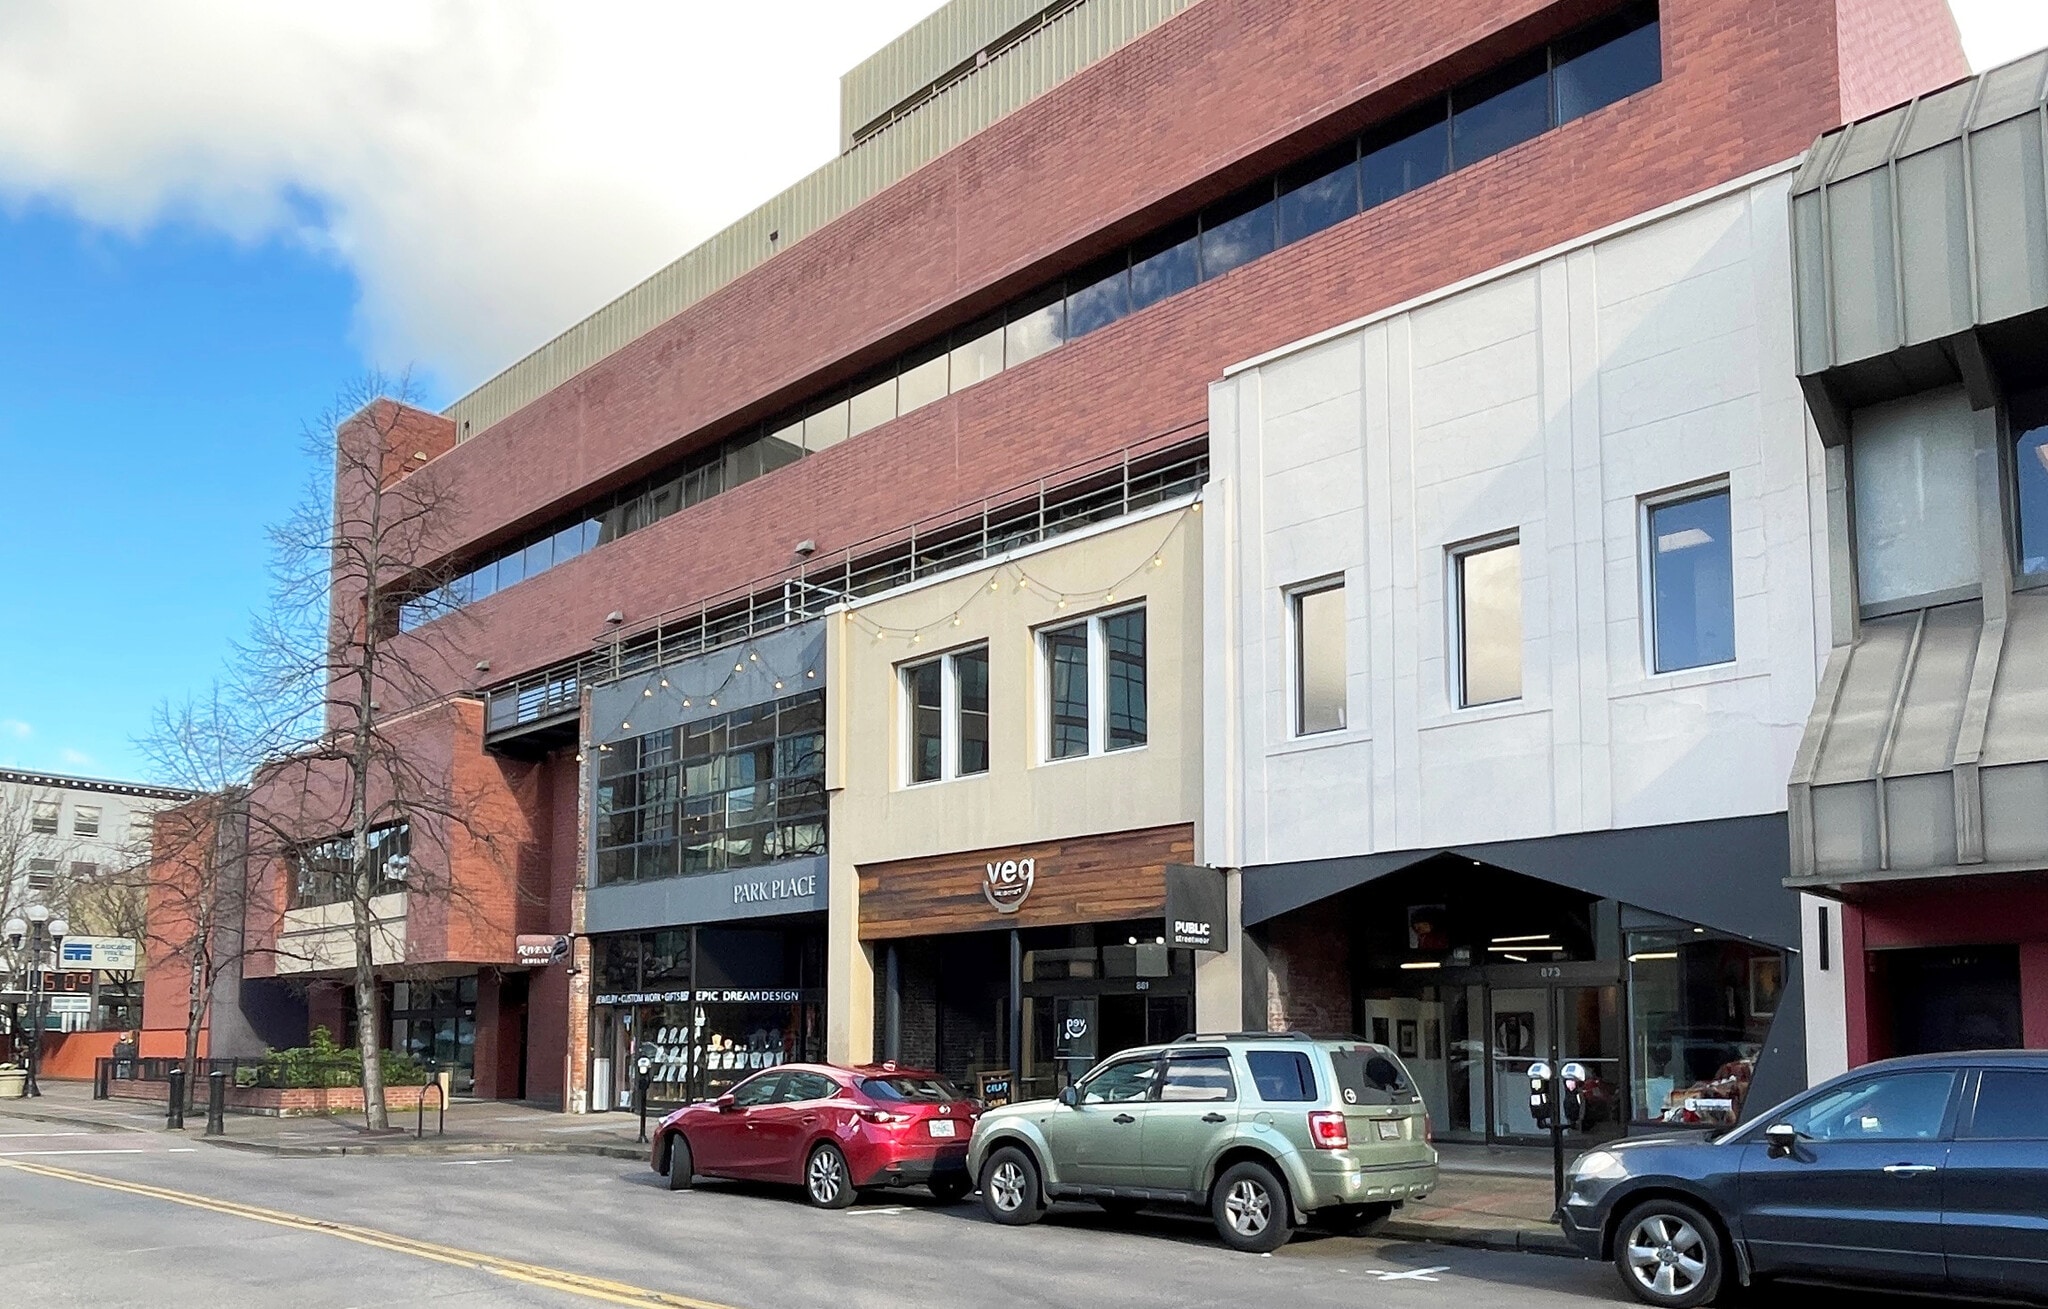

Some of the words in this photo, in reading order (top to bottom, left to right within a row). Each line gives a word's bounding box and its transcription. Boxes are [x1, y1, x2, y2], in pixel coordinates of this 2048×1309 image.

[986, 858, 1035, 890] veg
[734, 881, 769, 904] PARK
[771, 875, 816, 899] PLACE
[1175, 921, 1210, 935] PUBLIC
[1175, 935, 1210, 944] streetwear
[621, 993, 643, 1003] CUSTOM
[644, 993, 661, 1002] WORK
[695, 991, 719, 1001] EPIC
[723, 991, 760, 1001] DREAM
[761, 991, 799, 1001] DESIGN
